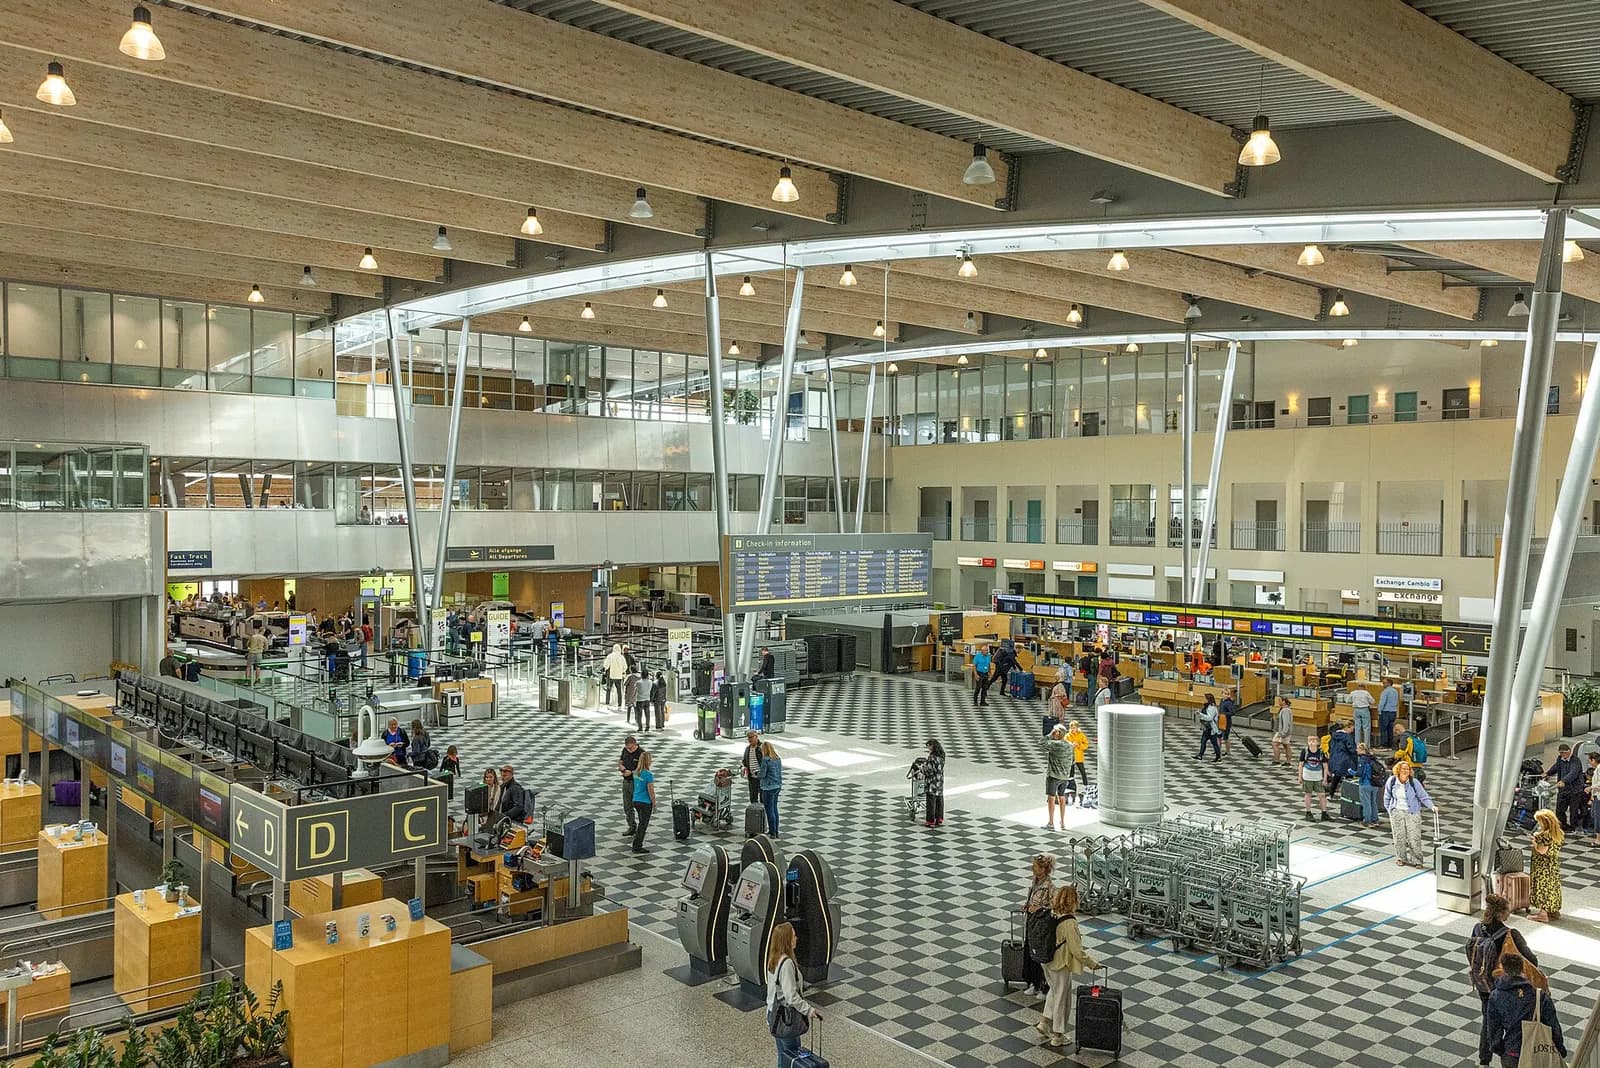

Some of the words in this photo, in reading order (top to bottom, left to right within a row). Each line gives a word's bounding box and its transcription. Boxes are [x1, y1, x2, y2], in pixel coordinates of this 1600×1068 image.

[746, 539, 772, 548] Check-in
[775, 539, 812, 547] information
[1376, 579, 1405, 587] Exchange
[488, 612, 509, 620] GUIDE
[669, 631, 691, 640] GUIDE
[404, 806, 427, 842] C
[264, 819, 275, 856] D
[310, 822, 336, 860] D
